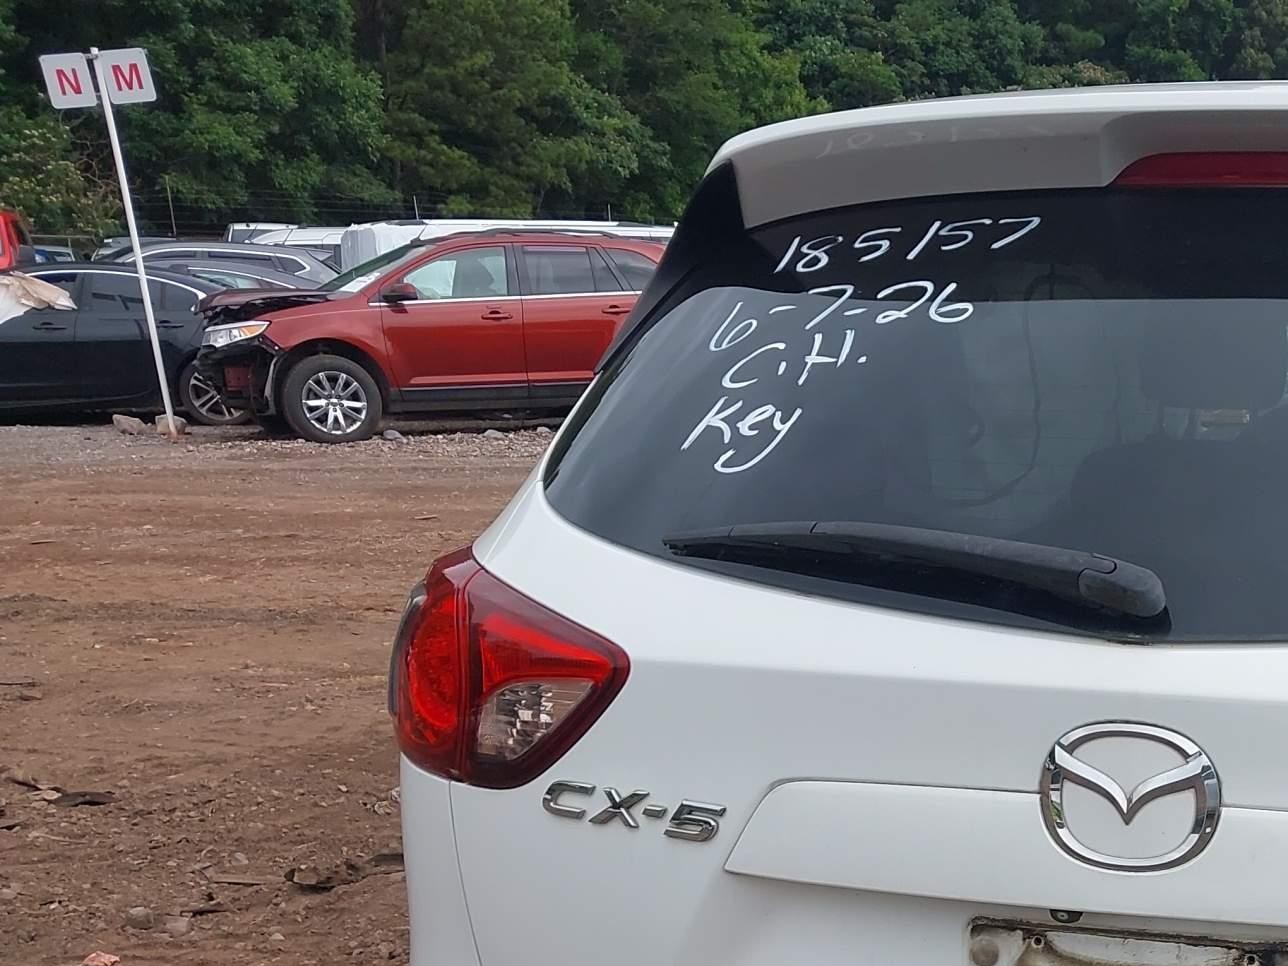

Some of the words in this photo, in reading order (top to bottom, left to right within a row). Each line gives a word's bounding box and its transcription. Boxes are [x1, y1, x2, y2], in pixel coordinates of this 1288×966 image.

[56, 67, 82, 96] N
[111, 63, 144, 92] M
[708, 280, 975, 352] 6-7-26
[680, 396, 803, 474] Key
[541, 779, 728, 842] CX-5
